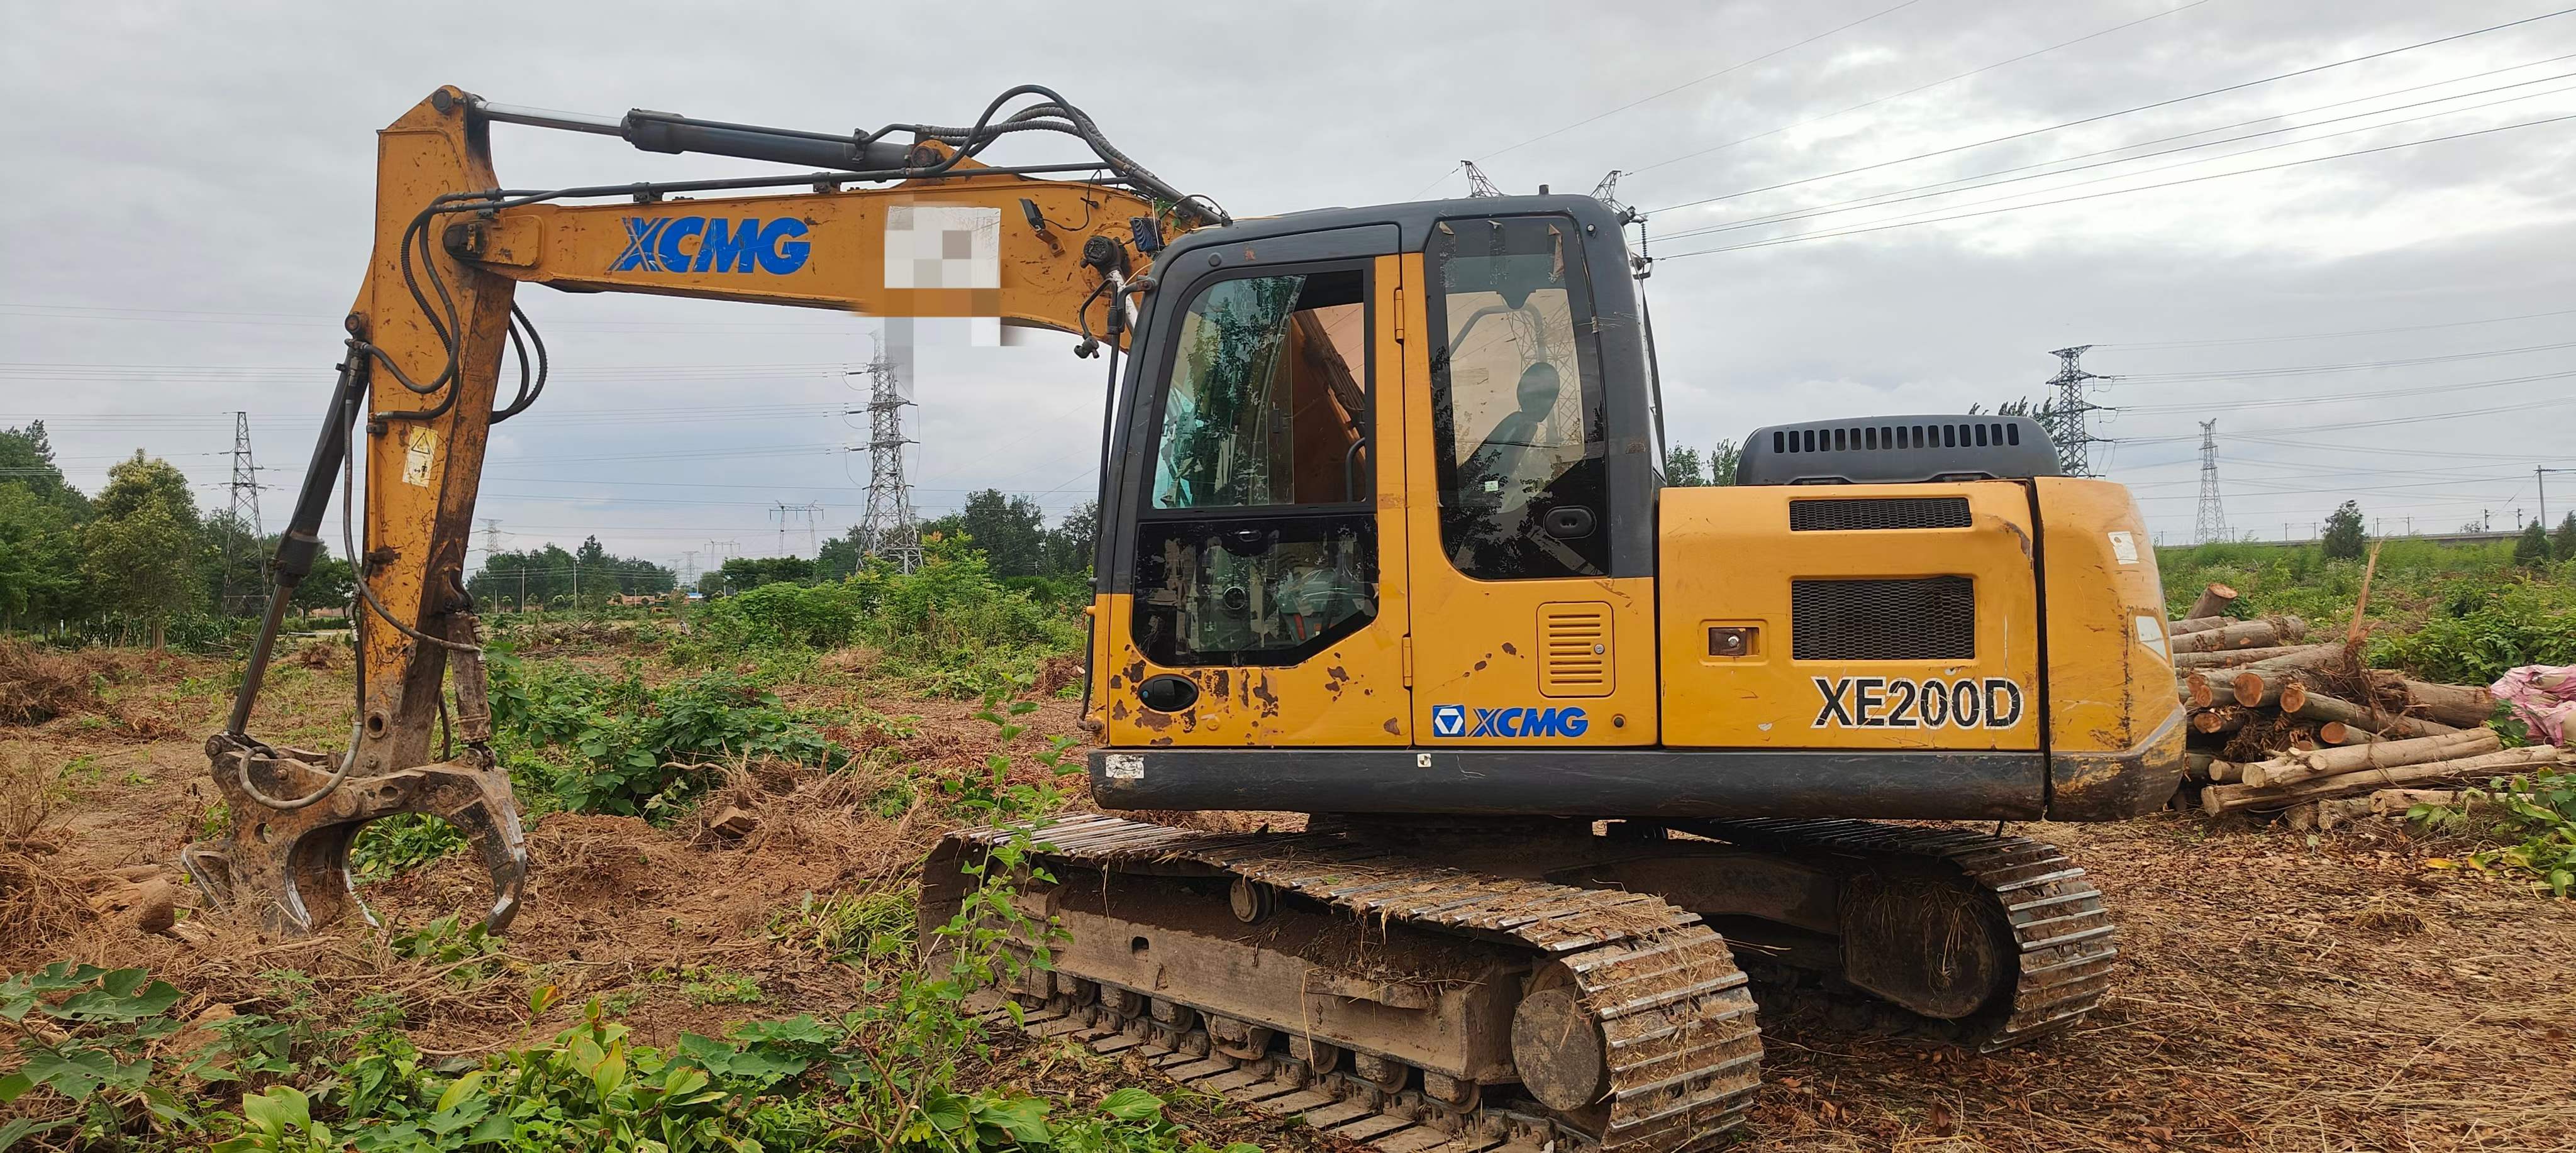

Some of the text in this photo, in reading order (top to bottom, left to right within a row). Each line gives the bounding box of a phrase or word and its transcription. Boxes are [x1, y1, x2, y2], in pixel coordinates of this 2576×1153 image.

[607, 217, 811, 274] XCMG
[1467, 707, 1589, 737] XCMG
[1812, 677, 2023, 729] XE200D
